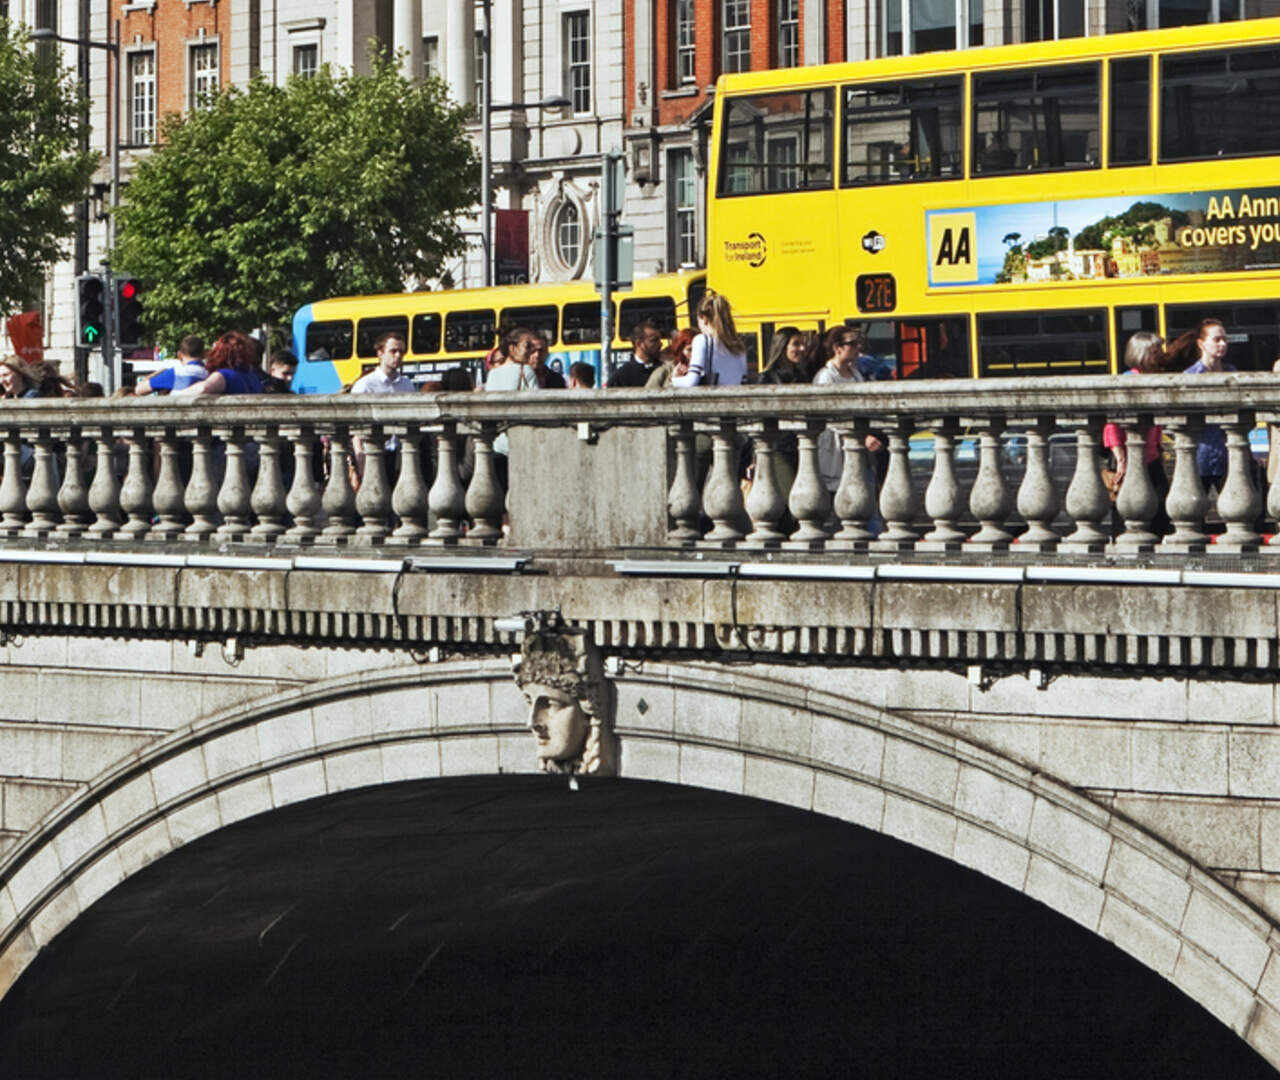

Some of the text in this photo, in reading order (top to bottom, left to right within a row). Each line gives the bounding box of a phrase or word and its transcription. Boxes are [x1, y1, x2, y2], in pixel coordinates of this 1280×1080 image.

[1207, 196, 1235, 220] AA
[724, 240, 761, 251] Transport
[936, 227, 971, 266] AA
[1181, 223, 1246, 248] covers
[735, 251, 761, 261] Ireland
